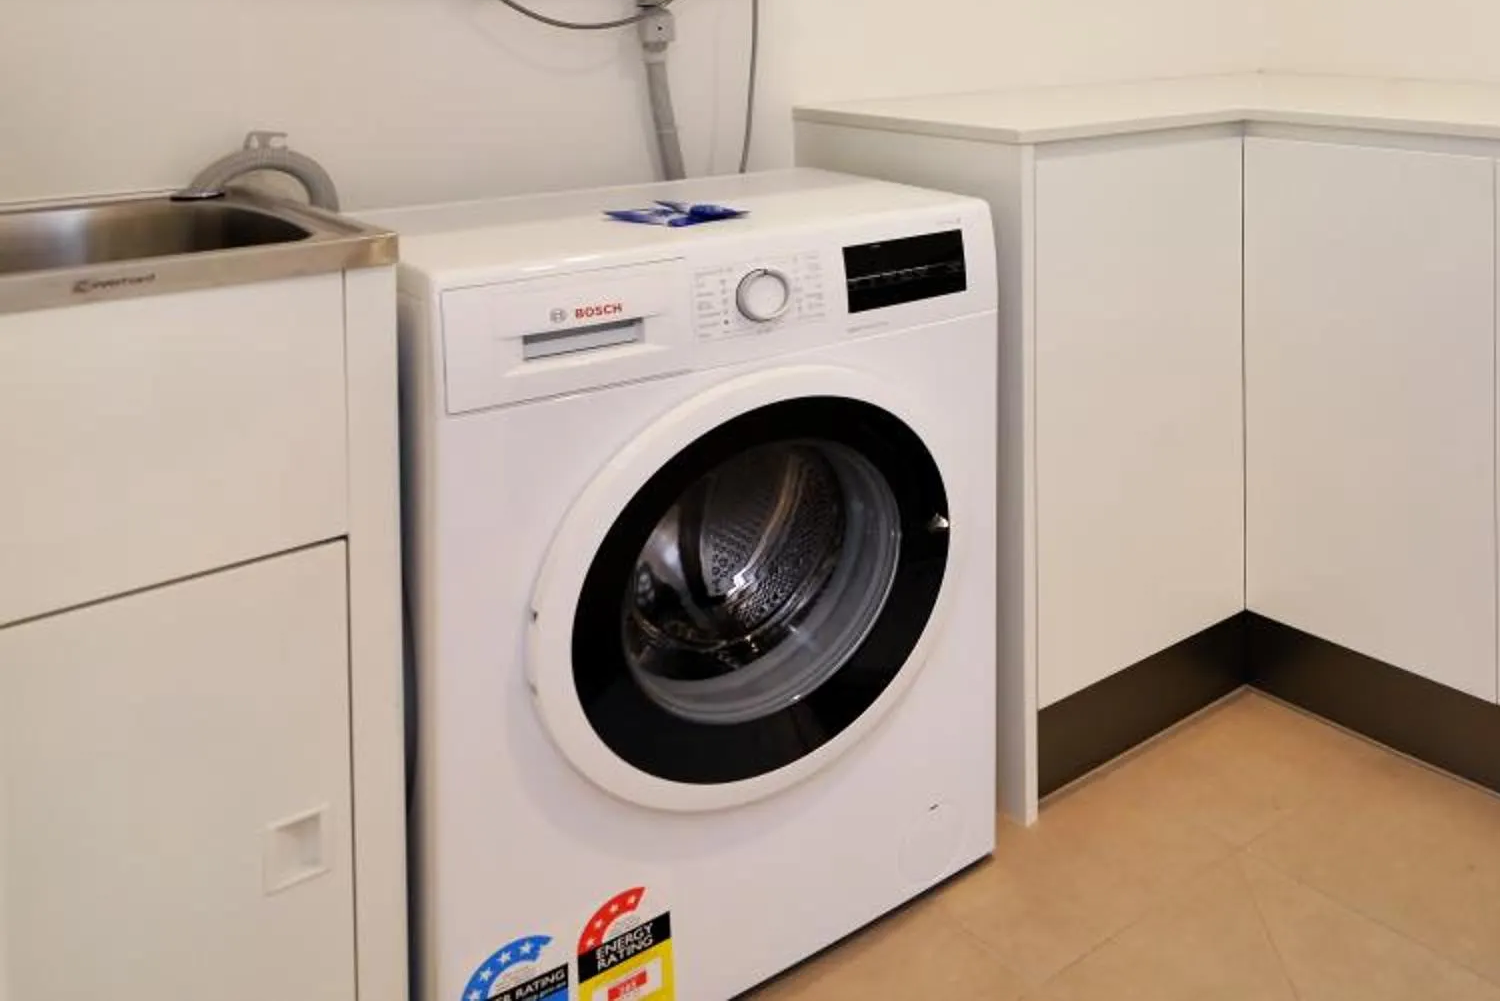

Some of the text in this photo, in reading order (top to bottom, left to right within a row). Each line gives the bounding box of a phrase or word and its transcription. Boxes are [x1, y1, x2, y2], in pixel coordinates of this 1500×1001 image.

[575, 302, 623, 319] BOSCH
[596, 922, 654, 963] ENERGY
[597, 934, 654, 972] RATING
[515, 968, 567, 1001] RATING
